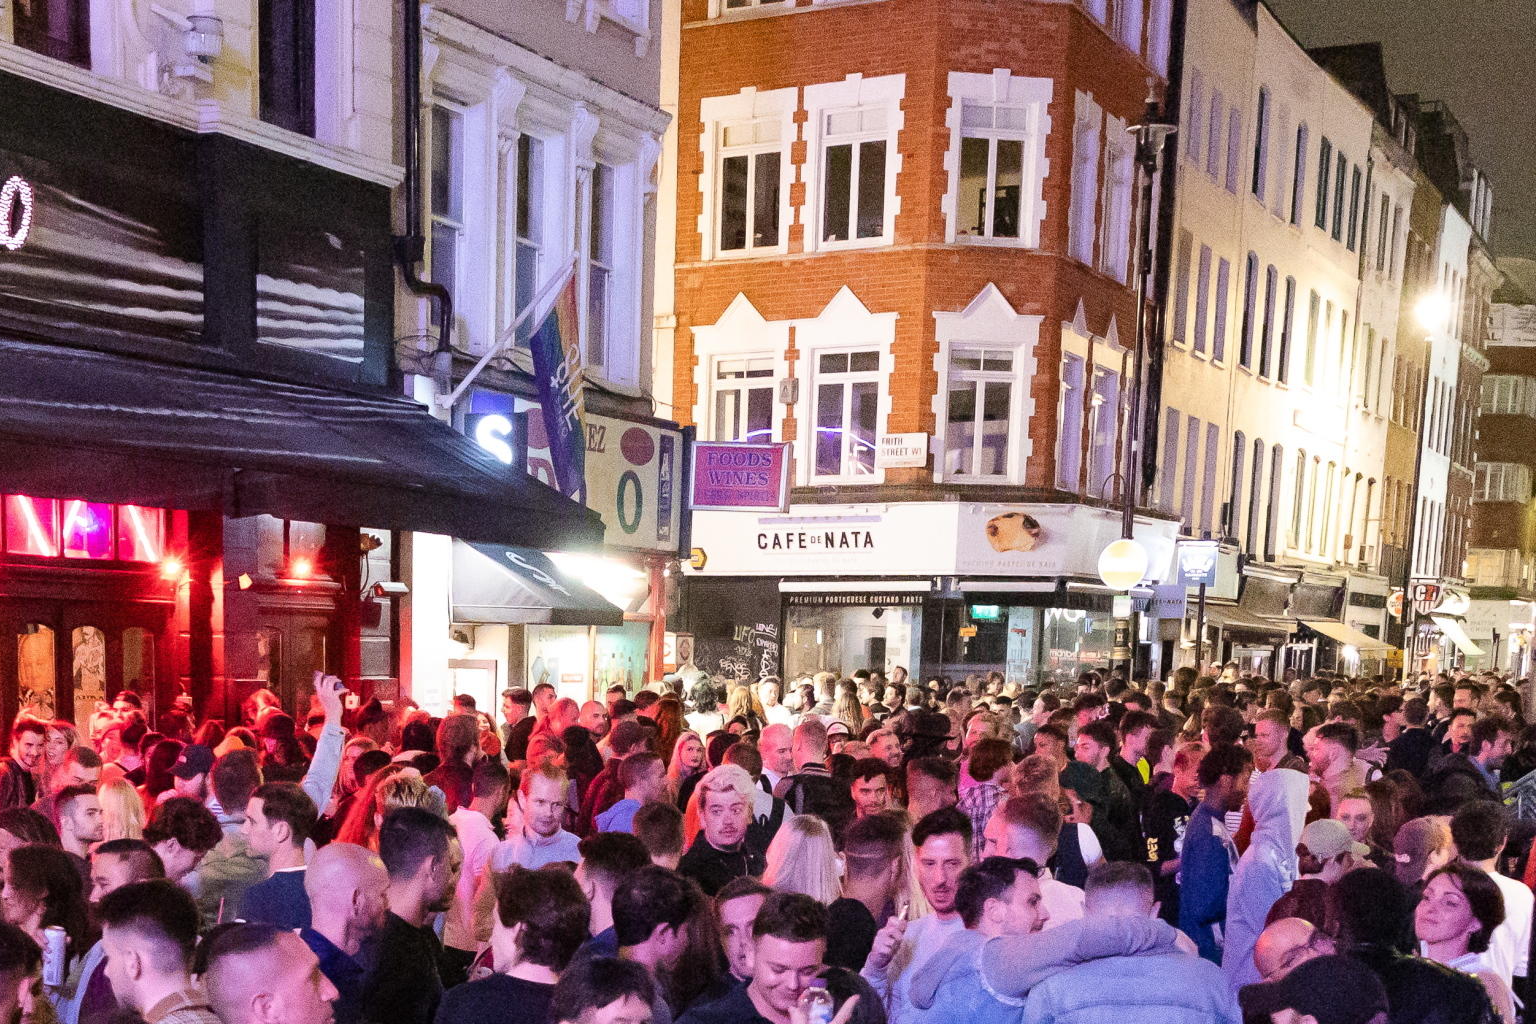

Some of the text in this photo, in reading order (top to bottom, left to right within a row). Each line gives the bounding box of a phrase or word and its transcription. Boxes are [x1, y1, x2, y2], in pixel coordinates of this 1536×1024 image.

[881, 437, 903, 446] FRITH
[881, 447, 908, 456] STREET
[707, 452, 772, 467] FOODS
[708, 470, 769, 486] WINES
[810, 535, 822, 544] DE
[824, 531, 874, 548] NATA
[790, 595, 923, 604] PREMIUM PORTUGUESE CUSTARD TARTS
